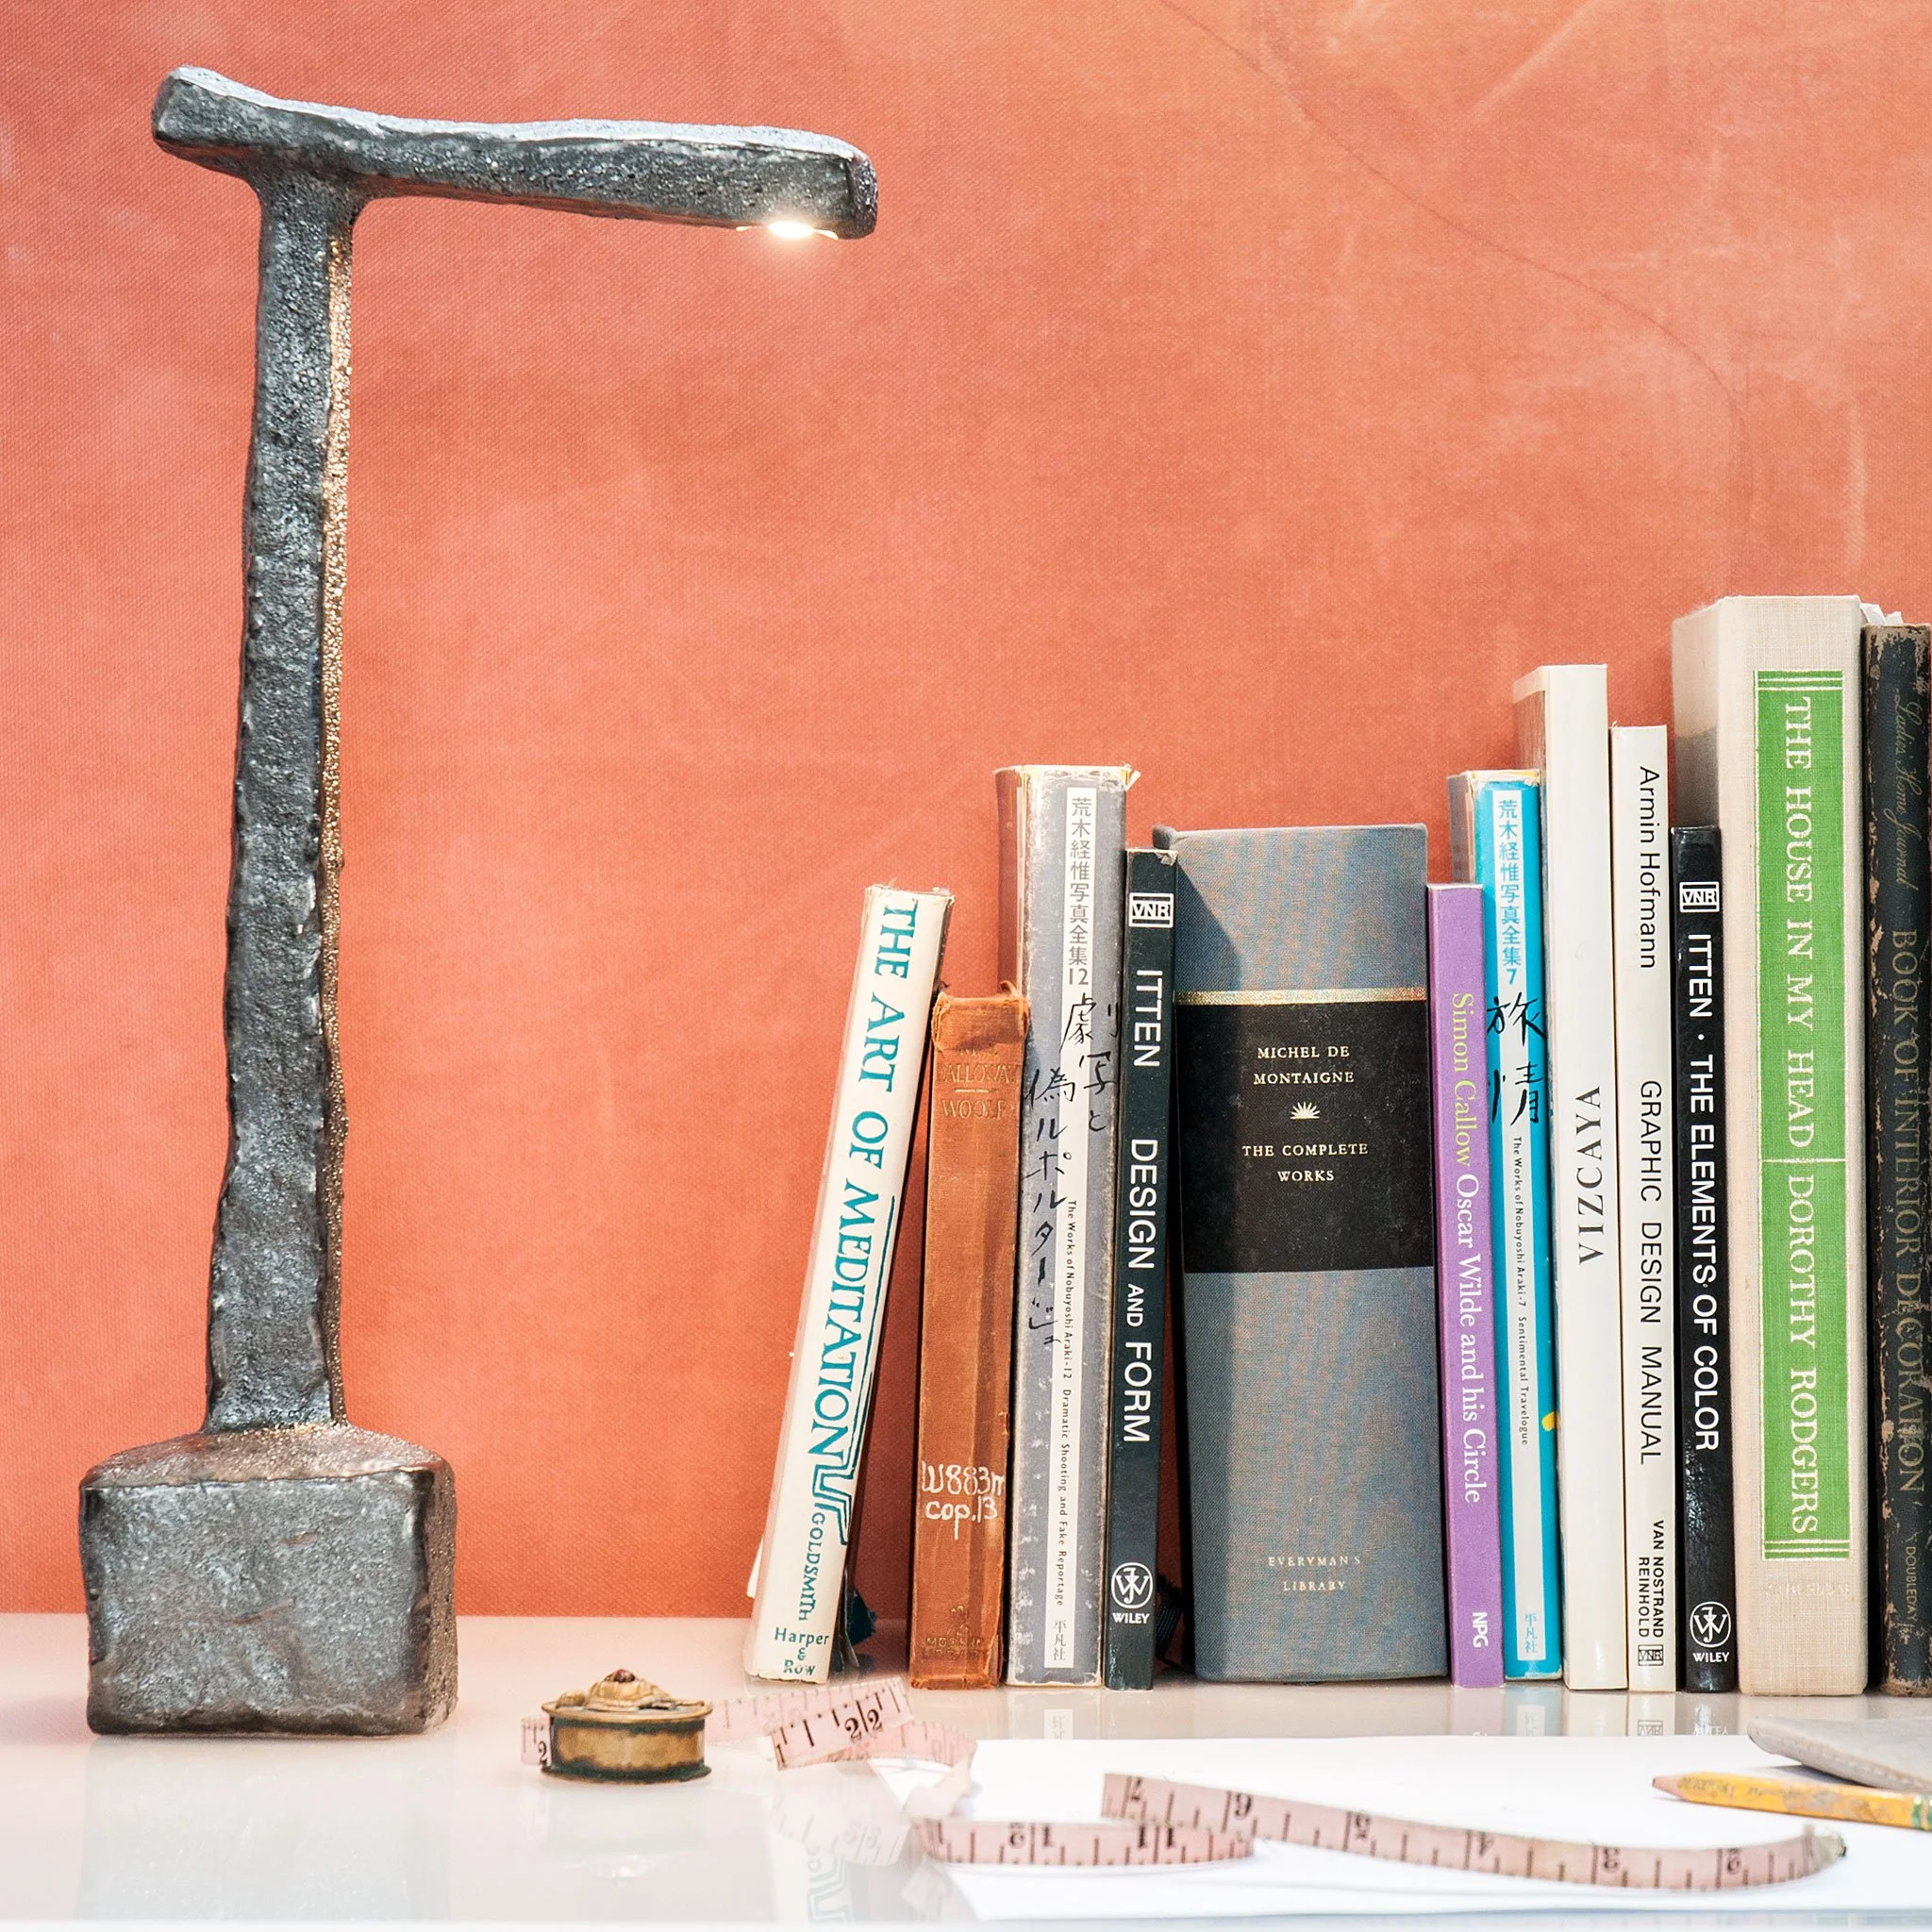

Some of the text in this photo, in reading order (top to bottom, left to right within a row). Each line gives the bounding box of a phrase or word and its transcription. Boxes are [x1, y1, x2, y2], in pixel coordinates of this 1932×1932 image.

[1640, 766, 1661, 969] Armin Hofmann
[1785, 696, 1814, 1148] THE HOUSE IN MY HEAD
[1257, 1045, 1350, 1058] MICHEL DE
[1253, 1072, 1355, 1085] MONTAIGNE
[1242, 1143, 1368, 1157] THE COMPLETE
[1513, 1137, 1522, 1155] The
[808, 899, 919, 1464] THE ART OF MEDITATION
[1277, 1171, 1335, 1182] WORKS
[1513, 1158, 1523, 1191] Works
[1514, 1194, 1524, 1206] of
[1575, 1086, 1604, 1265] VIZCAYA
[1688, 934, 1720, 1452] ITTEN THE ELEMENTS OF COLOR
[1067, 1199, 1076, 1219] The
[1124, 970, 1163, 1442] ITTEN DESIGN AND FORM
[1891, 930, 1925, 1492] BOOK OF INTERIOR DECORATION
[1066, 1223, 1076, 1254] Works
[1452, 993, 1487, 1503] Simon Callow Oscar Wilde and his Circle
[1513, 1207, 1524, 1263] Nobuyoshi
[1067, 1257, 1075, 1271] of
[1641, 1081, 1663, 1465] GRAPHIC DESIGN MANUAL
[1063, 1273, 1074, 1329] Nobuyoshi
[1518, 1316, 1528, 1381] Sentimental
[1788, 1174, 1818, 1534] DOROTHY RODGERS
[1061, 1389, 1071, 1439] Dramatic
[1519, 1386, 1529, 1445] Travelogue
[1058, 1444, 1070, 1491] Shooting
[1058, 1496, 1068, 1516] and
[1058, 1521, 1068, 1545] Fake
[798, 1512, 825, 1621] GOLDSMITH
[1056, 1551, 1067, 1606] Reportage
[1283, 1580, 1345, 1591] LIBRARY
[1653, 1520, 1664, 1638] VAN NOSTRAND
[1905, 1546, 1919, 1623] DOUBLEDAY
[1112, 1612, 1150, 1624] WILEY
[1639, 1557, 1650, 1638] REINHOLD
[774, 1627, 829, 1647] Harper
[1472, 1611, 1489, 1648] NPG
[1692, 1652, 1730, 1663] WILEY
